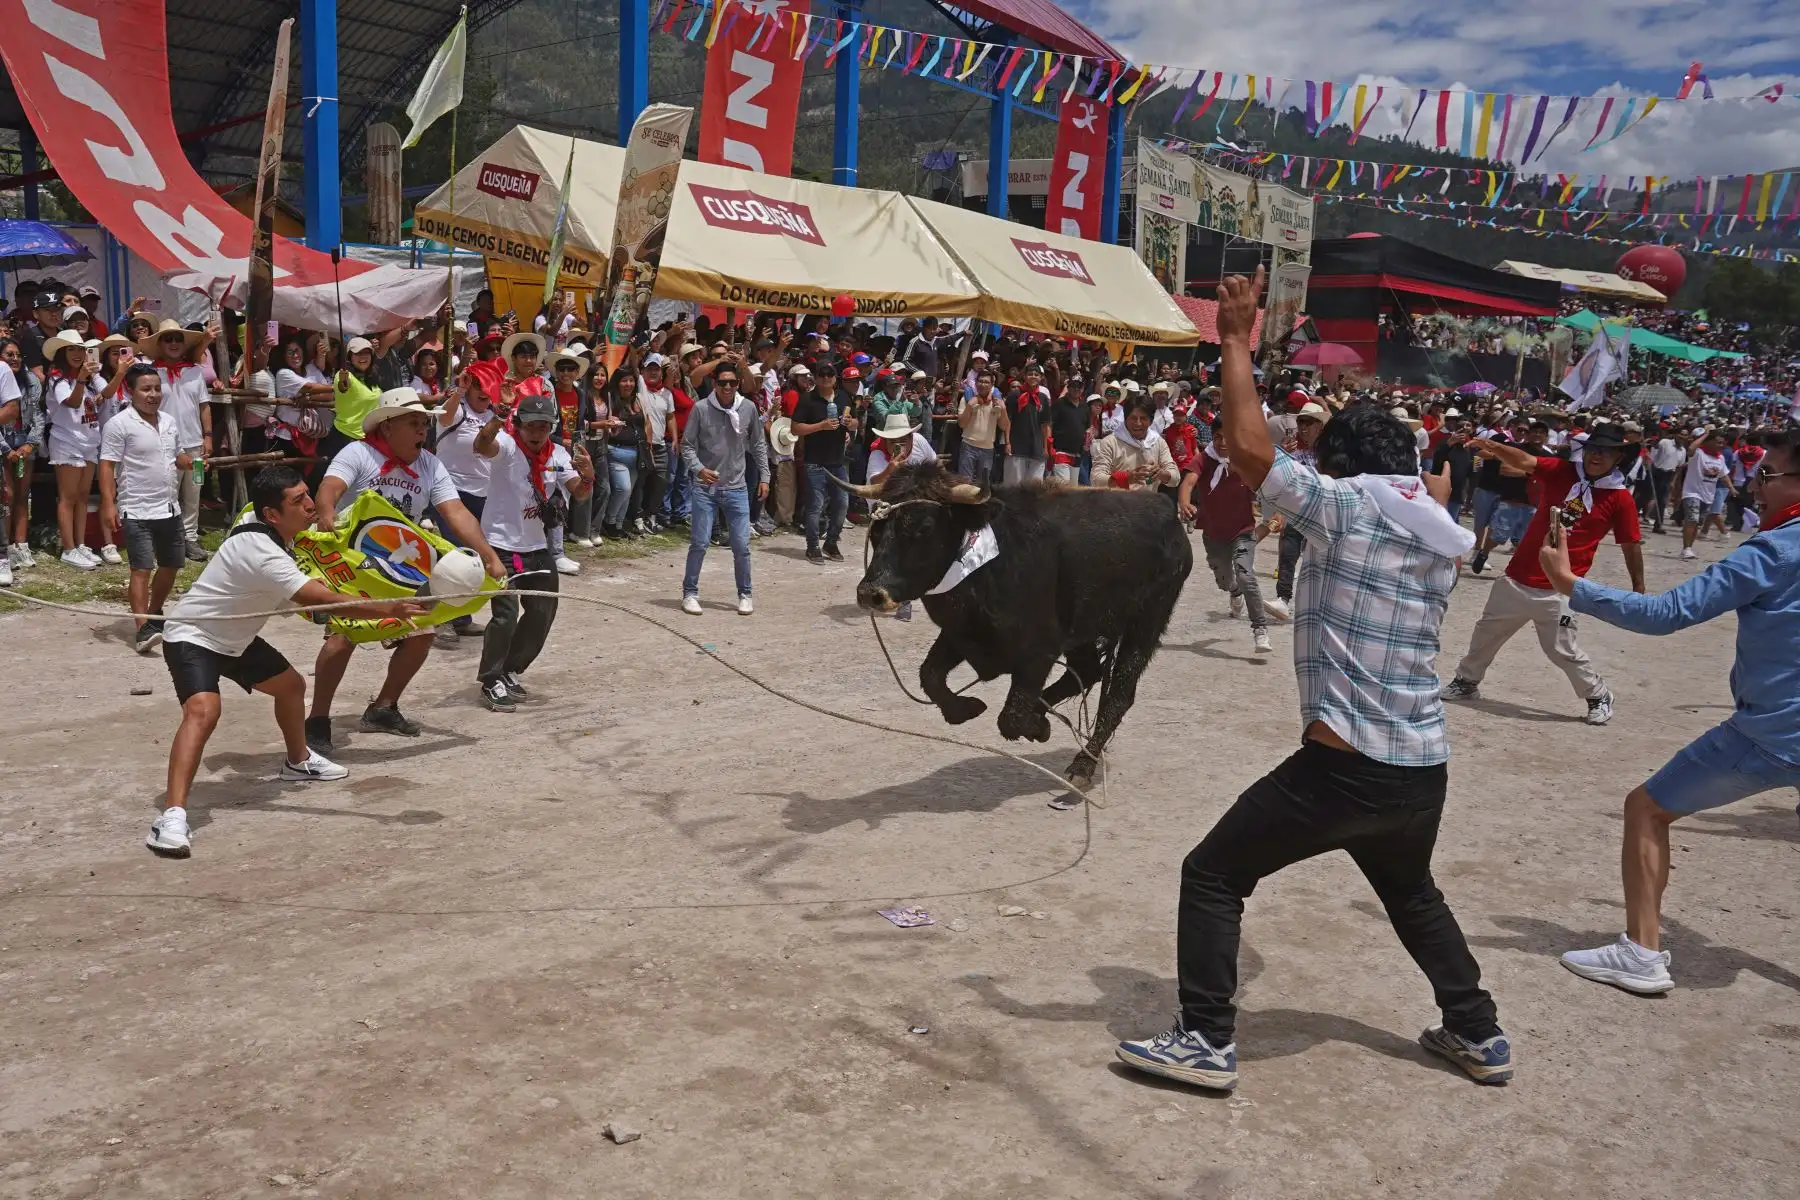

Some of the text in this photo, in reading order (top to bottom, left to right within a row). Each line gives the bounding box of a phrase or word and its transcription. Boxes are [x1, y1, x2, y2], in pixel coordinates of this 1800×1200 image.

[482, 170, 532, 196] CUSQUEÑA
[1140, 163, 1167, 191] SEMANA
[1168, 175, 1191, 198] SANTA
[702, 196, 815, 237] CUSQUEÑA
[1270, 205, 1309, 230] SEMANA SANTA
[418, 217, 433, 234] LO
[499, 240, 590, 276] LEGENDRIO
[1021, 247, 1088, 279] CUSQEÑA
[720, 284, 908, 314] LO HACEMOS LNDARIO
[1055, 318, 1160, 342] LO HACEMOS LEGENDARIO
[369, 477, 422, 495] AYACUCHO
